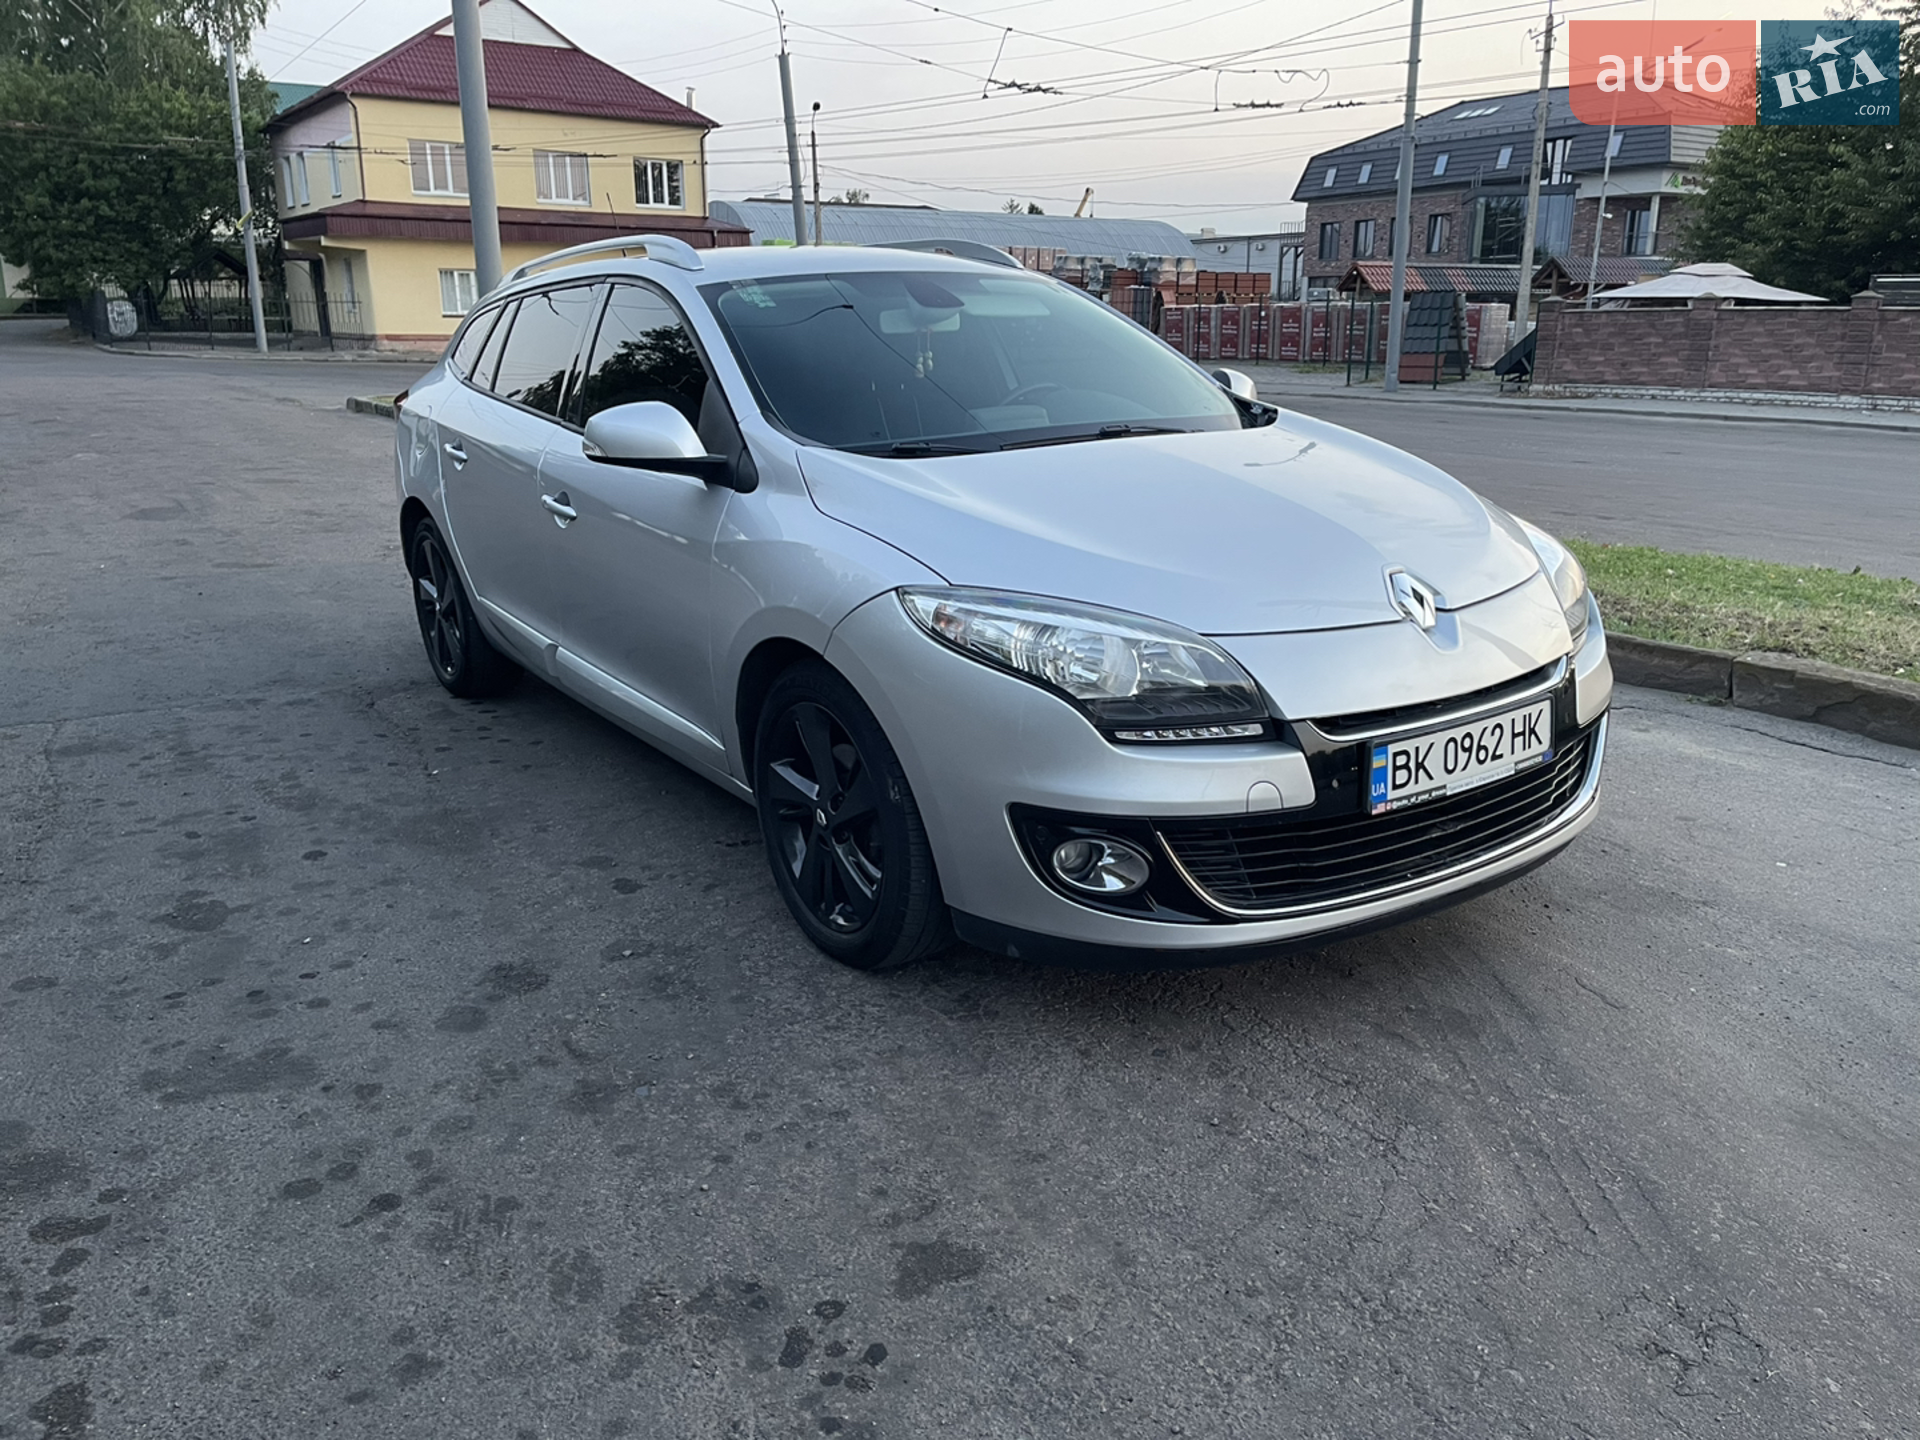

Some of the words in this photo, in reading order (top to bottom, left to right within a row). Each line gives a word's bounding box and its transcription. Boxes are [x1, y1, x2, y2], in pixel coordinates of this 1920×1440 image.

[1392, 742, 1435, 791] BK
[1444, 723, 1504, 775] 0962
[1511, 708, 1544, 756] HK
[1372, 784, 1386, 797] UA
